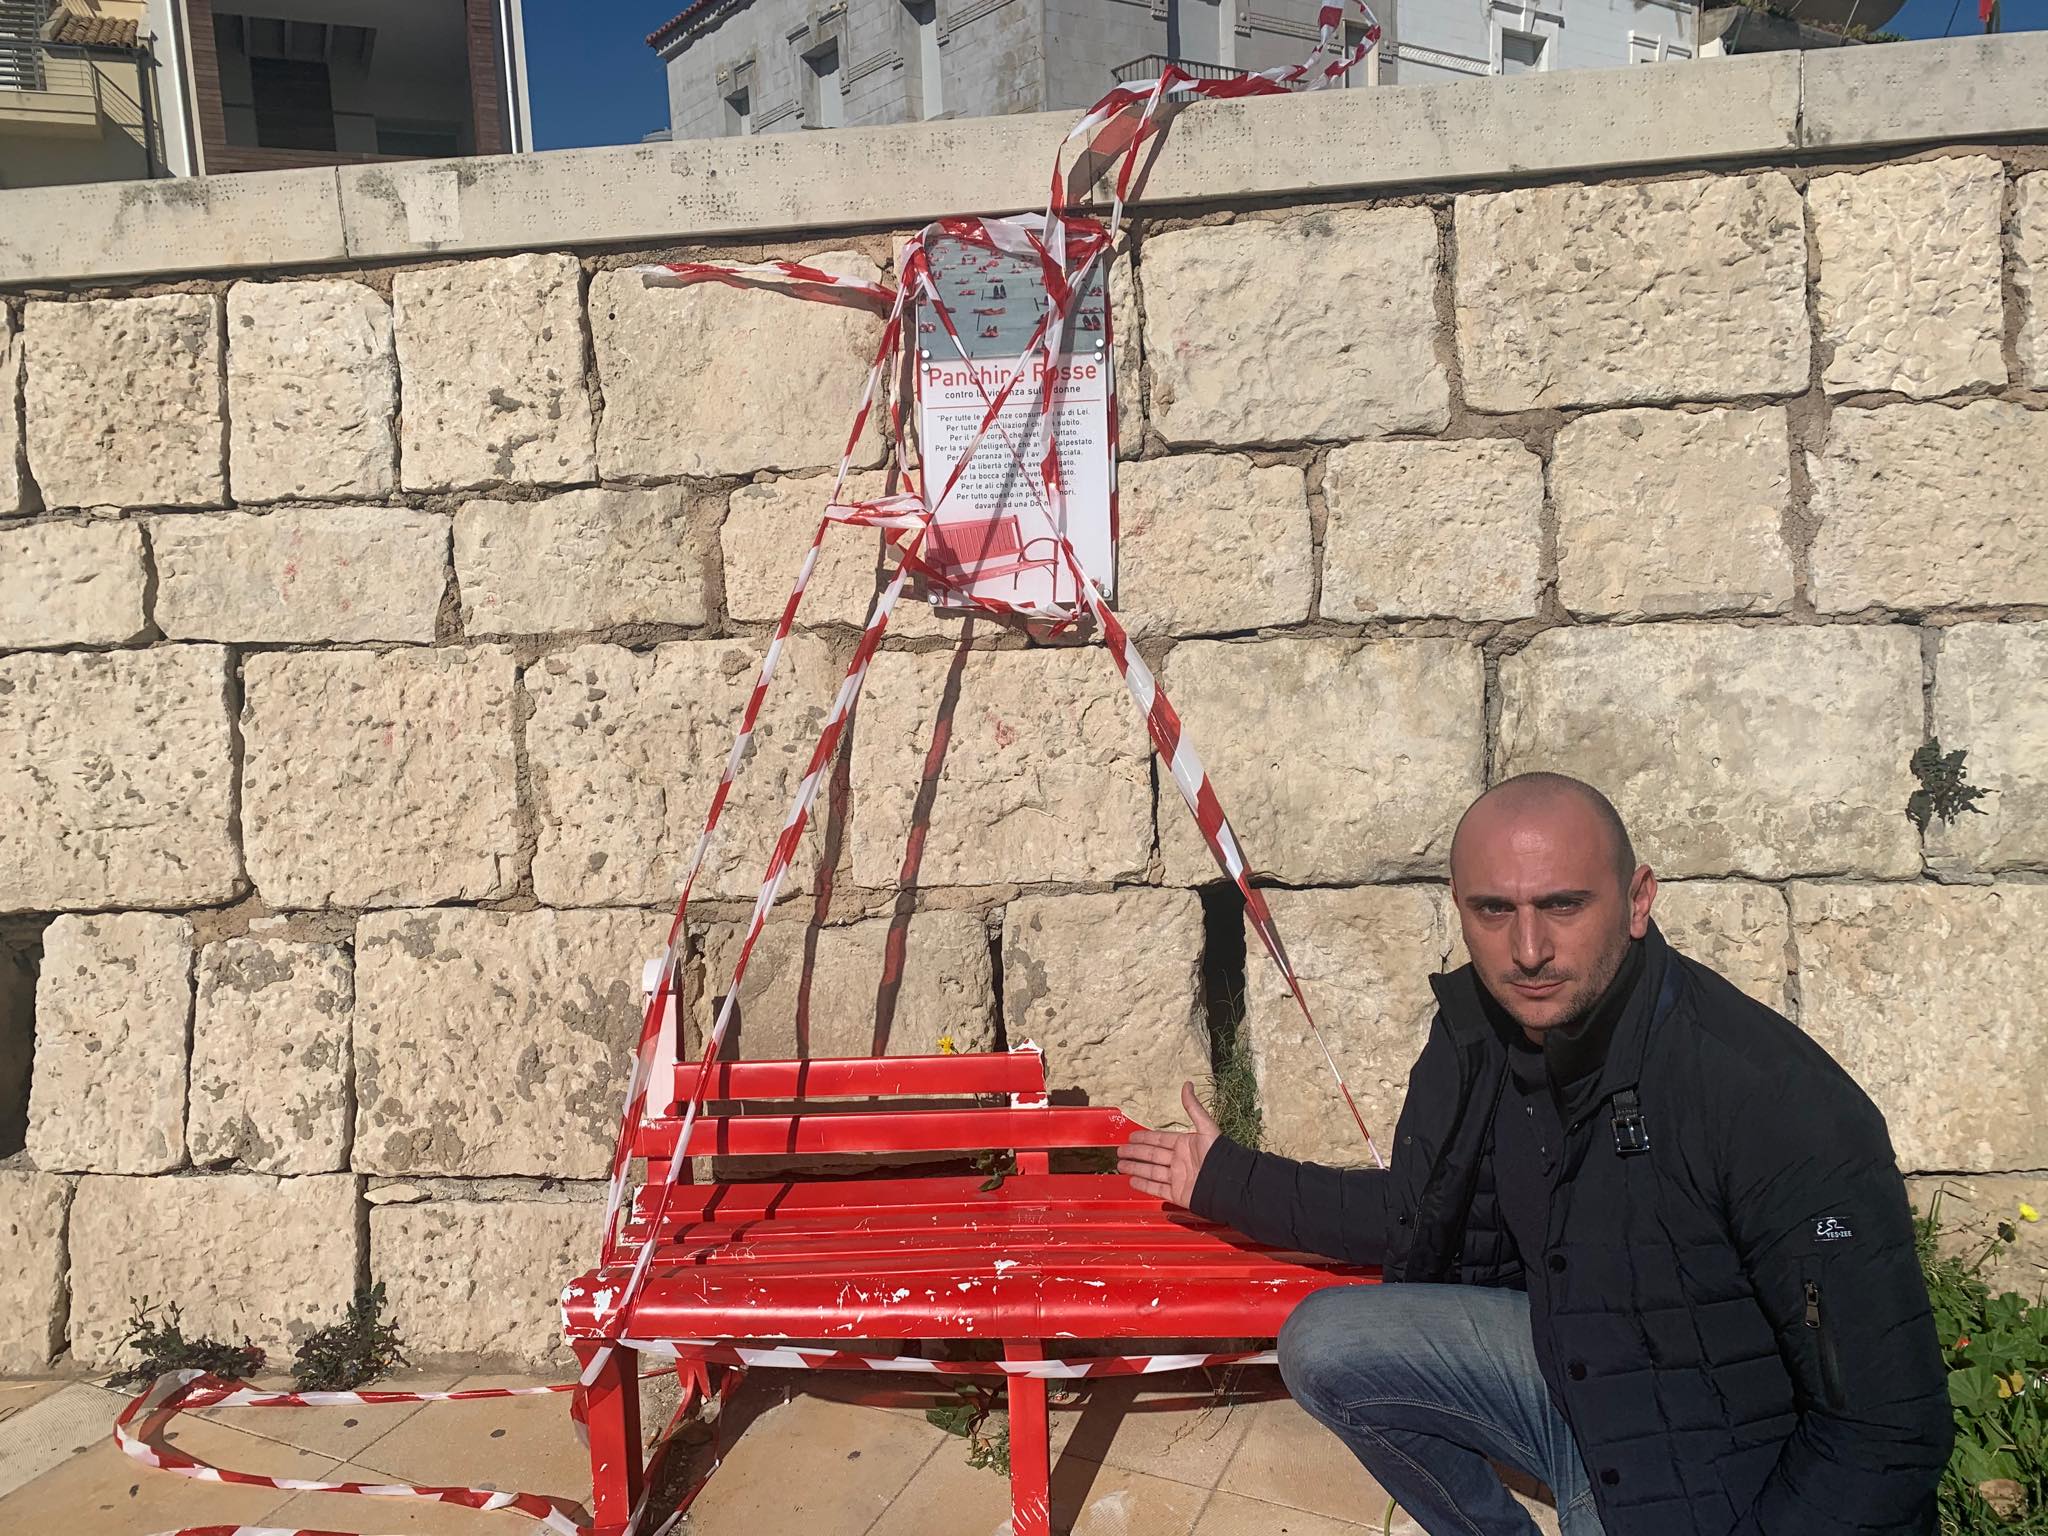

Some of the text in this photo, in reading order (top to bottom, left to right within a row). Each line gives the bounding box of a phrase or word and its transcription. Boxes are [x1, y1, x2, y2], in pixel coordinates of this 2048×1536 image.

[945, 390, 974, 399] contro
[987, 388, 1024, 397] vionza
[1028, 386, 1047, 395] sull
[1053, 386, 1080, 394] donne
[1018, 440, 1031, 448] che
[1056, 449, 1083, 457] asciata.
[978, 472, 999, 480] bocca
[1002, 471, 1014, 479] che
[961, 482, 973, 490] Per
[984, 481, 993, 489] ali
[996, 481, 1009, 489] che
[956, 492, 969, 500] Per
[971, 491, 987, 499] tutto
[990, 490, 1014, 500] questo
[1016, 490, 1023, 498] in
[975, 502, 1001, 510] davanti
[1003, 500, 1012, 508] ad
[1014, 500, 1027, 508] una
